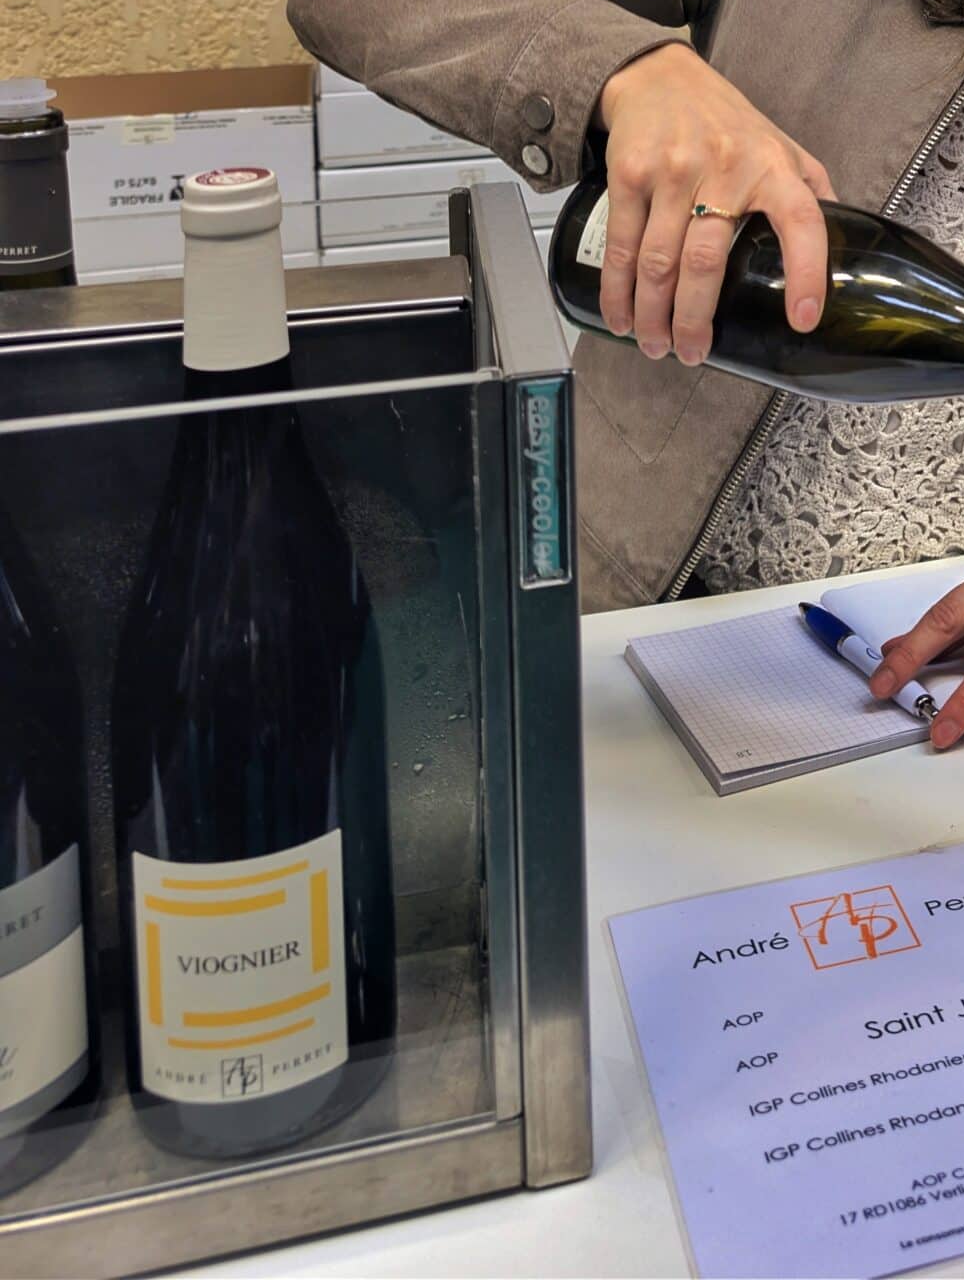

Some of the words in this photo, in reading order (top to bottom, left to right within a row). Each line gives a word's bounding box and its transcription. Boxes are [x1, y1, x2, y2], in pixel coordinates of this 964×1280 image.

[109, 192, 165, 208] FRAGILE
[177, 940, 302, 976] VIOGNIER
[692, 932, 790, 970] André
[722, 1010, 765, 1032] AOP
[736, 1051, 779, 1073] AOP
[864, 1005, 945, 1040] Saint
[271, 1042, 333, 1076] PERRET
[748, 1097, 785, 1118] IGP
[789, 1079, 868, 1107] Collines
[763, 1142, 801, 1165] IGP
[805, 1122, 887, 1153] Collines
[911, 1171, 947, 1191] AOP
[839, 1210, 858, 1227] 17
[862, 1193, 928, 1221] RD1086
[899, 1238, 914, 1250] Le
